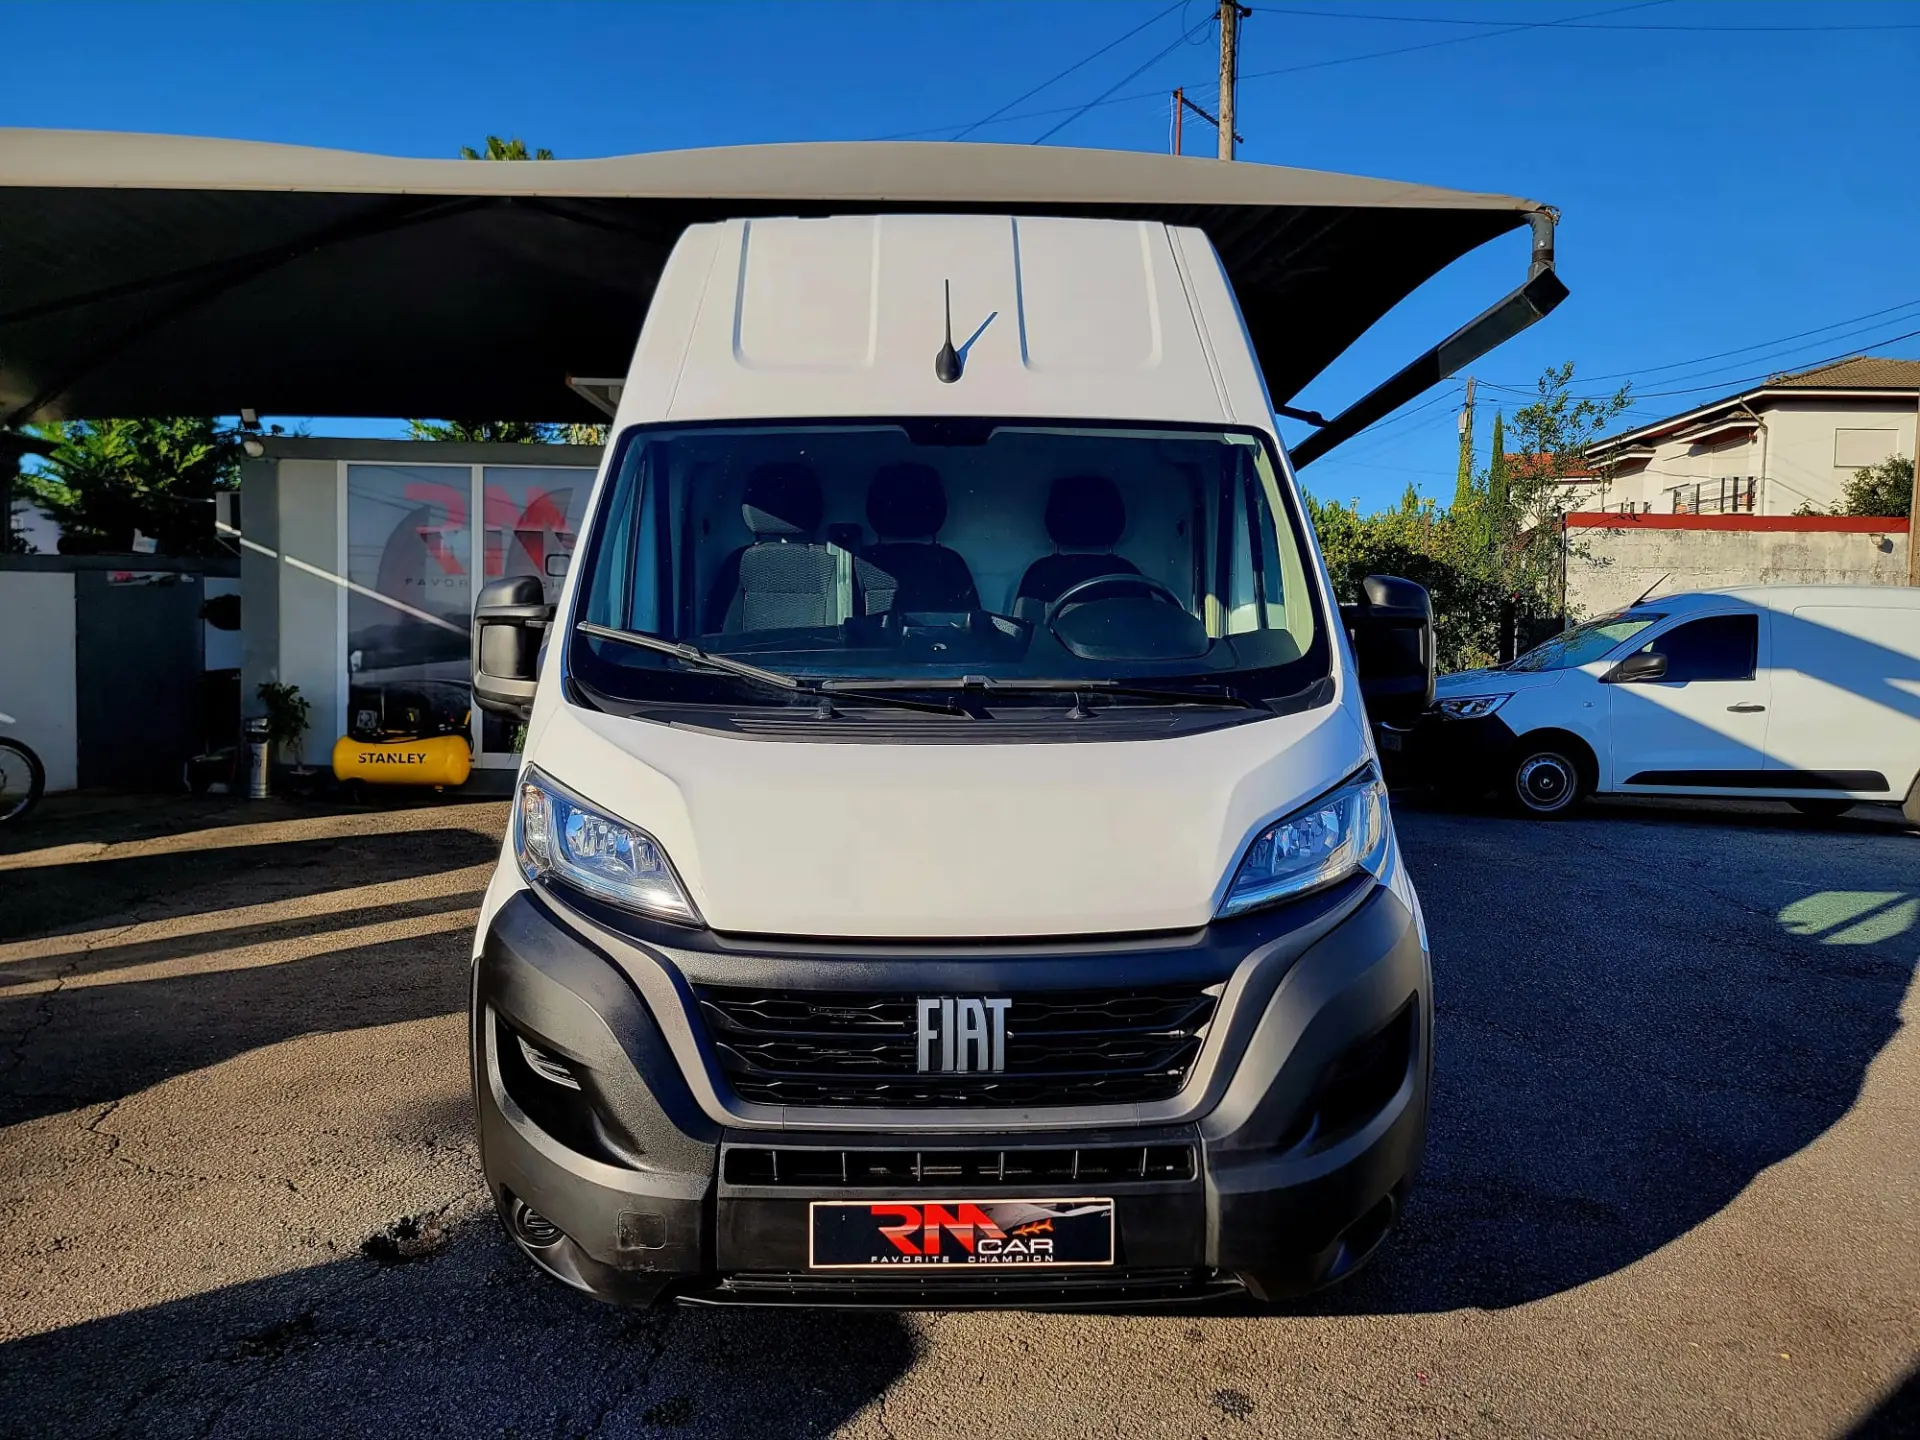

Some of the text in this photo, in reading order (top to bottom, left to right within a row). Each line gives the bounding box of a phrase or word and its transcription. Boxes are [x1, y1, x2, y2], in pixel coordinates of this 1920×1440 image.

[358, 752, 427, 764] STANLEY
[918, 997, 1012, 1072] FIAT
[870, 1203, 1054, 1254] RM CAR
[870, 1255, 1054, 1264] FAVORITE CHAMPION
